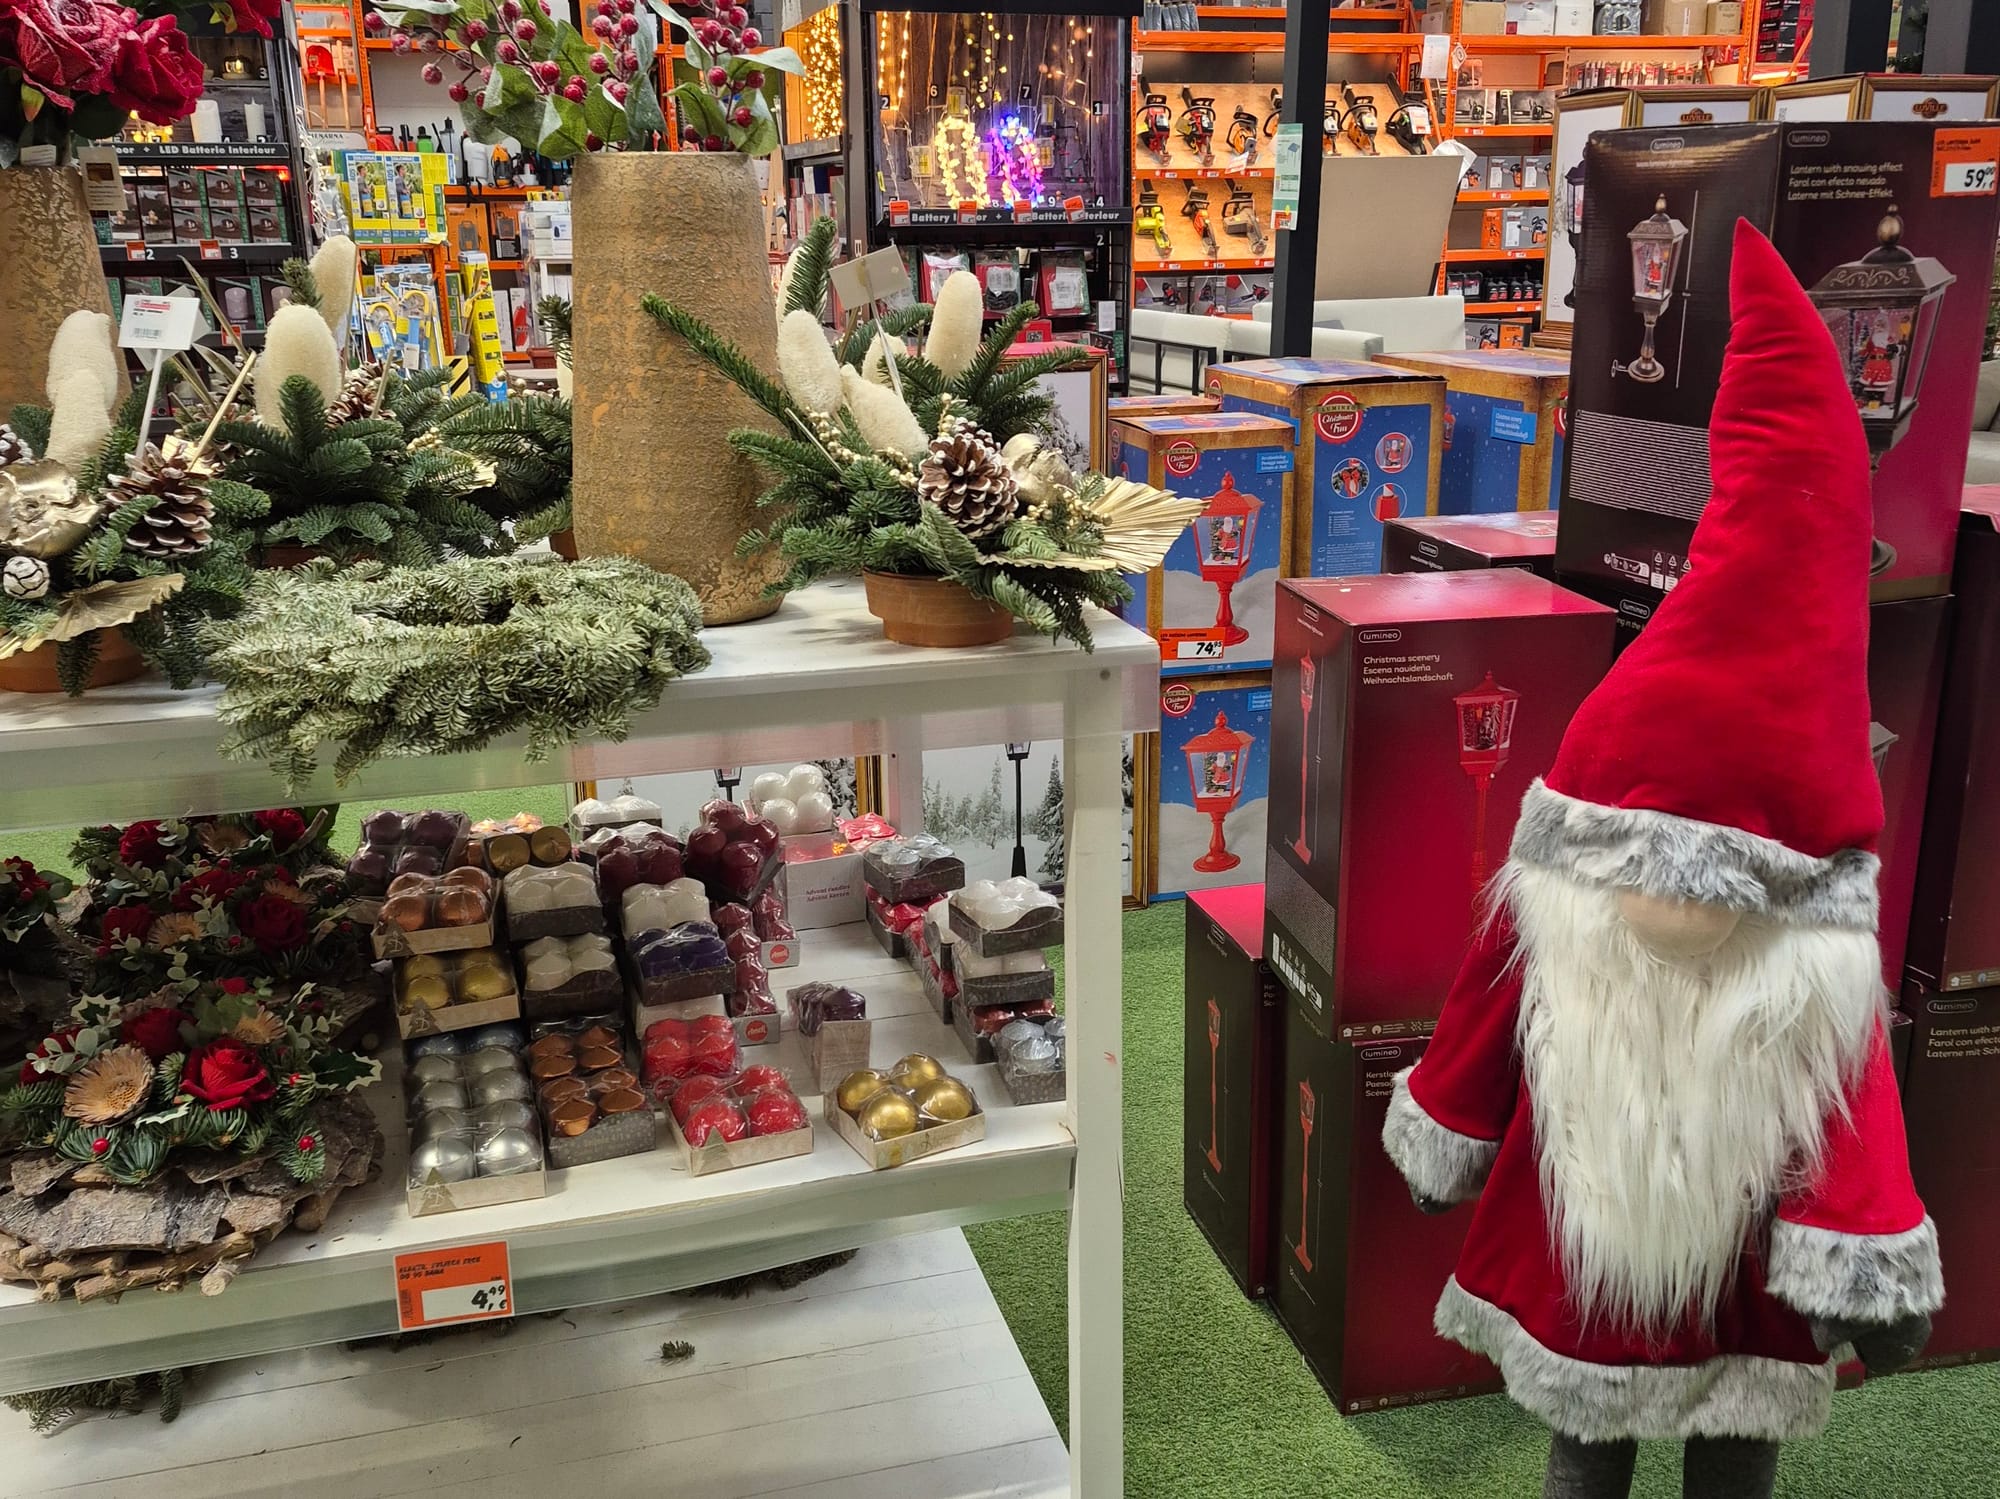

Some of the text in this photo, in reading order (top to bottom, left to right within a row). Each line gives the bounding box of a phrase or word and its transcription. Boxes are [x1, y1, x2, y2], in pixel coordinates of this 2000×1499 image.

[260, 67, 268, 79] 3
[930, 86, 938, 97] 6
[1023, 87, 1030, 98] 7
[881, 98, 889, 109] 2
[1094, 103, 1101, 114] 1
[1914, 104, 1947, 112] LUVILLE
[1791, 133, 1827, 142] lumineo
[159, 146, 178, 154] LED
[182, 146, 225, 154] Batterie
[228, 145, 276, 154] Interieur
[1653, 141, 1681, 150] lumineo
[1790, 162, 1903, 175] Lantern with snowing effect
[1789, 177, 1809, 187] Farol
[1811, 178, 1827, 186] con
[1828, 176, 1854, 186] efecto
[1788, 191, 1819, 201] Laterne
[1820, 190, 1834, 199] mit
[1048, 196, 1056, 207] 9
[1096, 196, 1104, 207] 4
[911, 214, 950, 224] Battery
[1097, 234, 1104, 246] 2
[146, 249, 155, 260] 2
[230, 248, 239, 259] 3
[1363, 632, 1398, 640] lumineo
[1363, 654, 1440, 665] Christmas scenery
[1363, 664, 1431, 675] Escena navideña
[1362, 672, 1454, 685] Weihnachtslandschaft
[1933, 1002, 1974, 1010] lumineo
[1930, 1027, 1968, 1036] Lantern
[1969, 1025, 1990, 1034] with
[1928, 1038, 1954, 1047] Farol
[1365, 1049, 1398, 1058] lumineo
[1926, 1049, 1964, 1057] Laterne
[1965, 1048, 1981, 1056] mit
